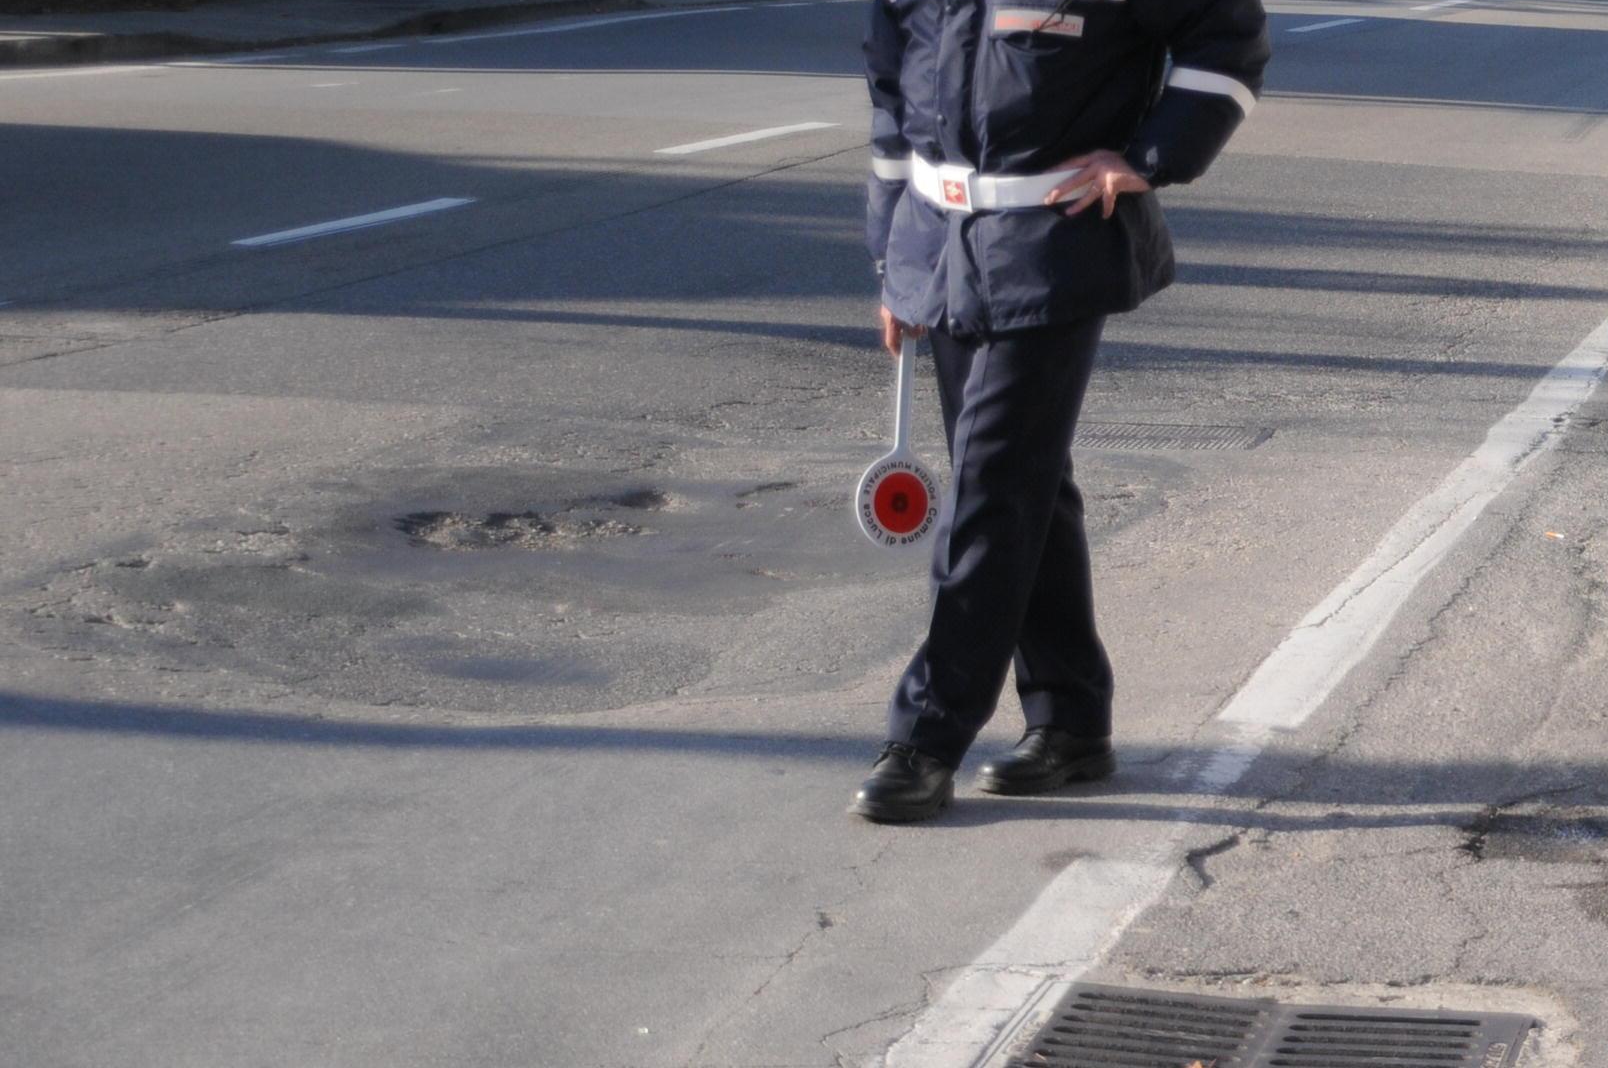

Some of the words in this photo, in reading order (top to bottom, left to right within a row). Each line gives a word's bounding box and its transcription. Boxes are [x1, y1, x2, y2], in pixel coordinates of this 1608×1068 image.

[863, 461, 913, 495] MUNICIPALE
[914, 465, 937, 500] POLIZIA
[863, 503, 884, 540] Lucca
[900, 507, 938, 545] Comune
[884, 535, 897, 546] di
